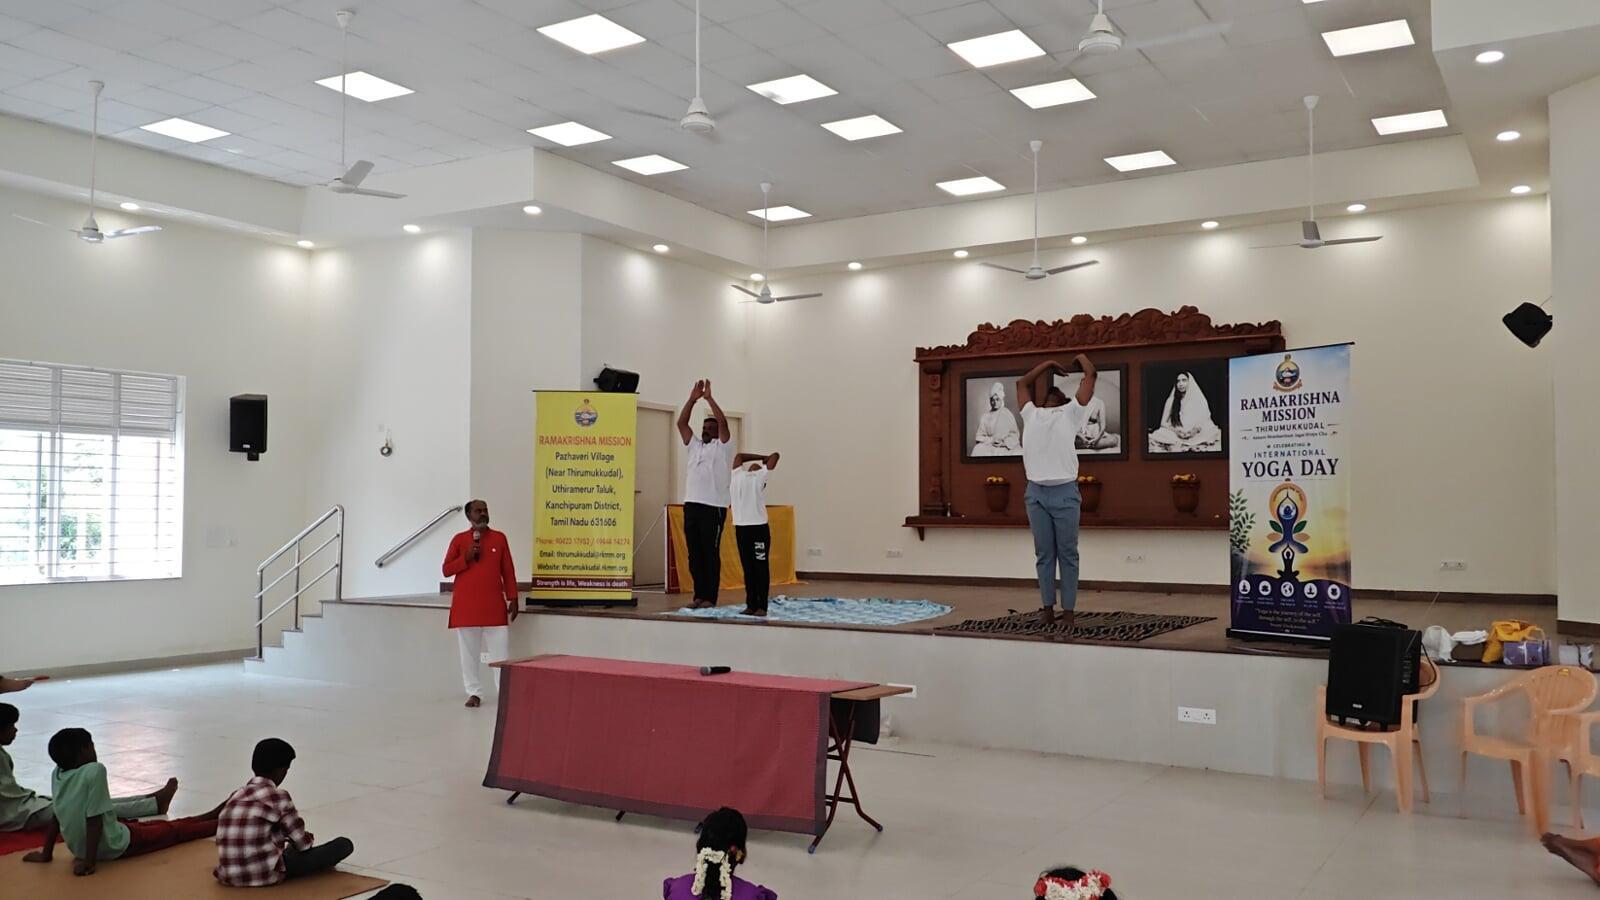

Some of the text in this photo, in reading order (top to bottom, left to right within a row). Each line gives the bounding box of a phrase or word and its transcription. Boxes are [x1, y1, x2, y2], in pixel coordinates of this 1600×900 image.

[1241, 391, 1340, 410] RAMAKRISHNA
[1262, 407, 1316, 422] MISSION
[1256, 423, 1325, 432] THIRUMUKKUDAL
[539, 435, 631, 446] RAMAKRISHNA MISSION
[556, 452, 614, 463] Pazhaveri Village
[1254, 449, 1325, 458] INTERNATIONAL
[546, 468, 565, 479] (Near
[1242, 459, 1338, 477] YOGA DAY
[552, 485, 616, 495] Uthiramerur Taluk,
[546, 501, 622, 512] Kanchipuram District,
[591, 518, 616, 526] 631606
